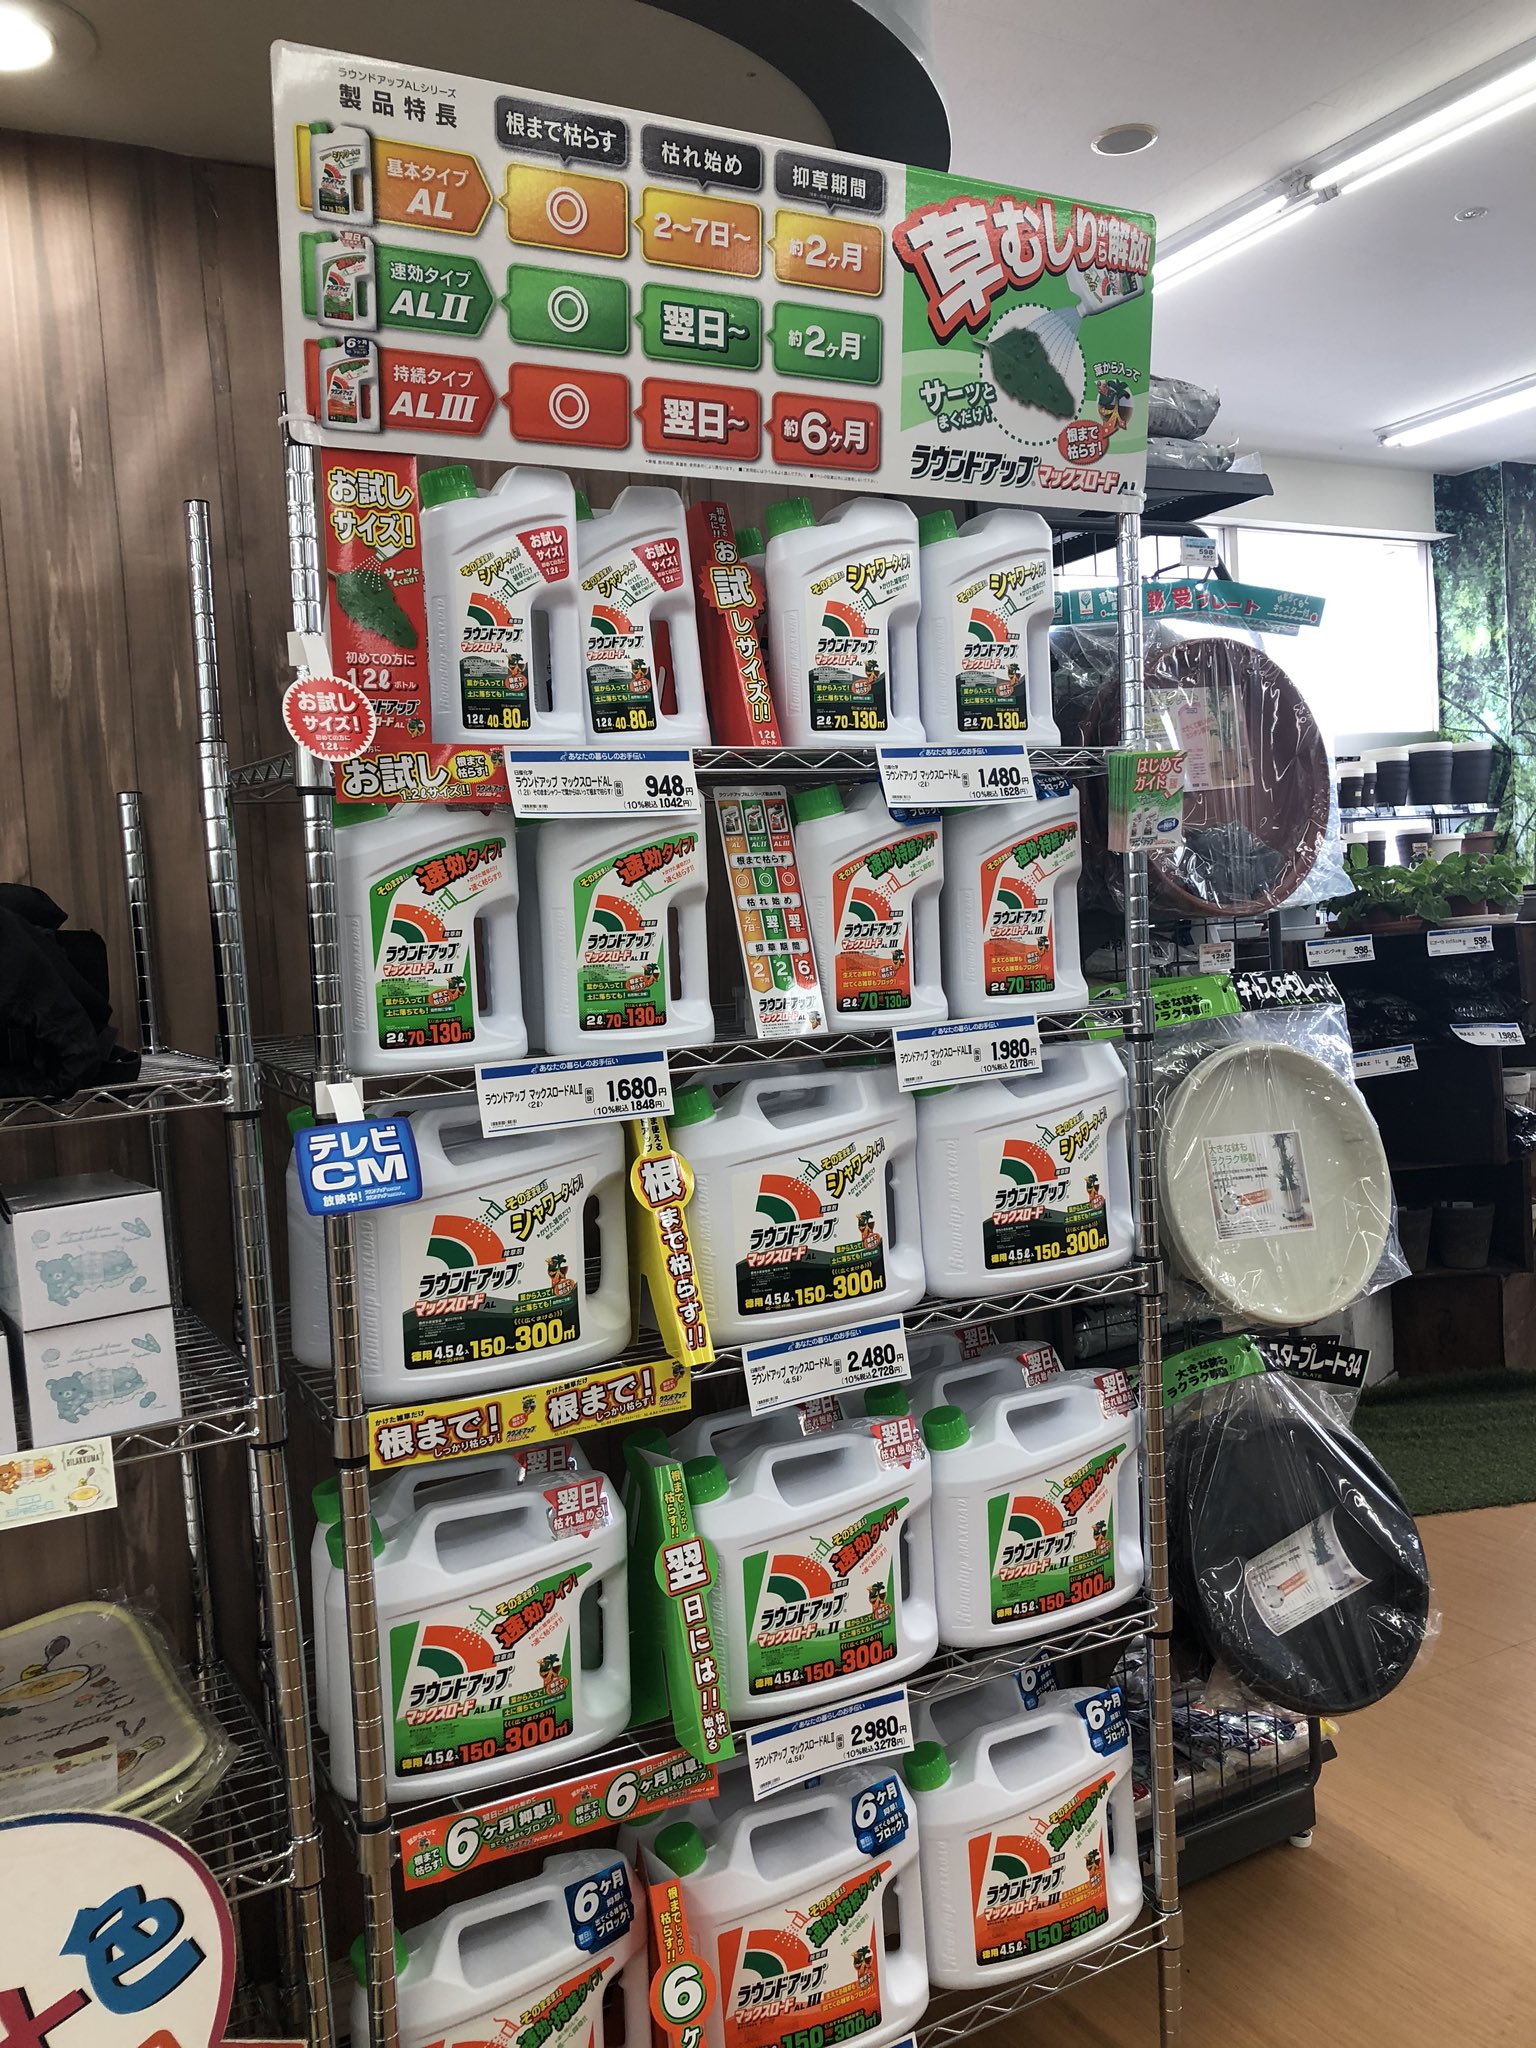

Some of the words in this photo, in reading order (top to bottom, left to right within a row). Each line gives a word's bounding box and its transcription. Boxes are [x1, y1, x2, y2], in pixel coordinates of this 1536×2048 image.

[338, 66, 457, 99] ラウンドアップALシリーズ
[338, 83, 457, 129] 製品特長
[506, 111, 617, 153] 根まで枯らす
[661, 141, 742, 176] 枯れ始め
[386, 157, 469, 189] 基本タイプ
[792, 165, 866, 200] 抑草期間
[407, 188, 453, 219] AL
[390, 262, 472, 288] 速効タイプ
[393, 364, 474, 388] 持続タイプ
[938, 405, 991, 430] まくだけ!
[1067, 426, 1098, 442] 根まで
[1068, 443, 1103, 460] 枯らす!
[330, 470, 412, 506] お試し
[333, 511, 413, 545] サイズ!
[529, 529, 563, 549] お試し
[536, 546, 564, 561] サイズ!
[644, 542, 676, 560] お試し
[651, 557, 679, 571] サイズ!
[463, 627, 524, 642] ラウンドアップ
[588, 635, 644, 649] ラウンドアップ
[817, 638, 878, 654] ラウンドアップ
[964, 644, 1018, 658] ラウンドアップ
[346, 651, 415, 666] 初めての方に
[298, 692, 356, 713] お試し
[303, 716, 361, 733] サイズ!
[455, 754, 485, 767] 根まで
[568, 752, 646, 761] あなたの暮らしのお手伝い
[1137, 757, 1183, 773] はじめて
[344, 753, 448, 797] お試し
[457, 766, 489, 778] 枯らす!
[516, 776, 558, 788] ラウンドアップ
[886, 770, 917, 781] ラウンドアップ
[1134, 776, 1166, 791] ガイド
[415, 843, 503, 894] 速効タイプ!
[737, 855, 786, 864] 根まで枯らす
[747, 896, 793, 907] 枯れ始め
[993, 910, 1046, 925] ラウンドアップ
[844, 922, 902, 938] ラウンドアップ
[588, 933, 656, 950] ラウンドアップ
[386, 943, 459, 962] ラウンドアップ
[539, 1057, 619, 1073] あなたの暮らしのお手伝い
[901, 1051, 929, 1064] ラウンドアップ
[485, 1090, 526, 1106] ラウンドアップ
[309, 1125, 401, 1163] テレビ
[311, 1153, 408, 1191] CM
[322, 1191, 363, 1207] 放映中!
[995, 1180, 1070, 1210] ラウンドアップ
[511, 1174, 584, 1242] シャワータイプ!
[751, 1218, 839, 1250] ラウンドアップ
[419, 1262, 525, 1298] ラウンドアップ
[795, 1328, 862, 1349] あなたの暮らしのお手伝い
[546, 1378, 588, 1395] かけた雑草だけ
[752, 1367, 786, 1386] ラウンドアップ
[375, 1410, 425, 1426] かけた雑草だけ
[596, 1396, 655, 1421] しっかり枯らす!
[434, 1432, 501, 1457] しっかり枯らす!
[67, 1454, 100, 1467] RILAKKUMA
[829, 1506, 898, 1577] 速効タイプ!
[1003, 1530, 1077, 1565] ラウンドアップ
[492, 1573, 578, 1648] 速効タイプ!
[761, 1593, 849, 1632] ラウンドアップ
[410, 1666, 514, 1707] ラウンドアップ
[754, 1748, 788, 1770] ラウンドアップ
[575, 1800, 599, 1815] 根まで
[876, 1818, 906, 1843] ブロック!
[413, 1849, 440, 1867] 根まで
[414, 1858, 444, 1877] 枯らす!
[987, 1866, 1065, 1906] ラウンドアップ
[596, 1909, 631, 1938] ブロック!
[60, 1884, 207, 2015] 色
[738, 1963, 829, 2008] ラウンドアップ
